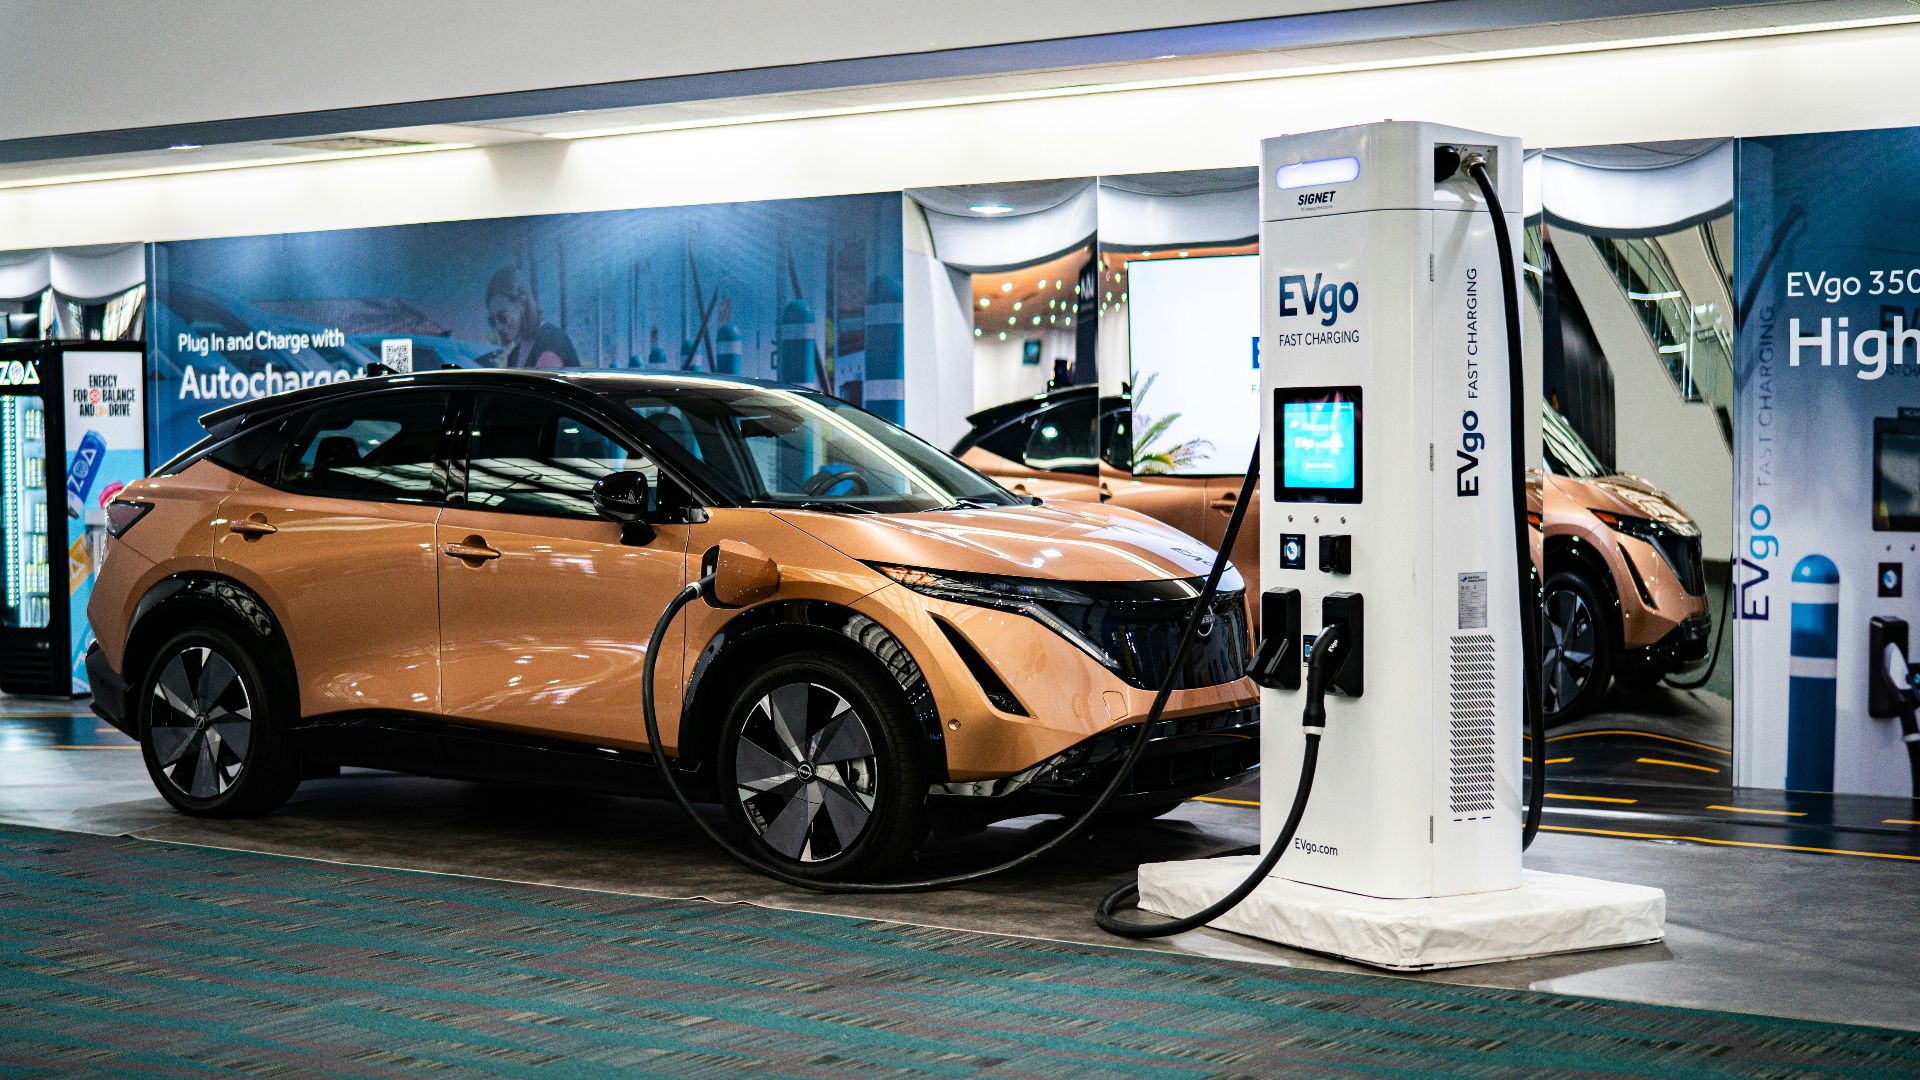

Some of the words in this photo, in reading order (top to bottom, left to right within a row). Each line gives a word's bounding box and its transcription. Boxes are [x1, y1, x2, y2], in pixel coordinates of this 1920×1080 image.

[1298, 190, 1336, 206] SIGNET
[1279, 273, 1359, 327] EVgo
[1787, 271, 1861, 303] EVgo
[1868, 268, 1920, 295] 350
[1466, 268, 1478, 355] CHARGING
[178, 333, 209, 357] Plug
[211, 332, 225, 352] In
[227, 331, 254, 352] and
[256, 329, 310, 354] Charge
[312, 327, 345, 349] with
[1279, 333, 1303, 347] FAST
[1305, 329, 1360, 346] CHARGING
[1789, 315, 1920, 381] High
[89, 374, 118, 388] ENERGY
[1468, 359, 1478, 399] FAST
[1759, 306, 1775, 427] CHARGING
[73, 389, 88, 403] FOR
[102, 388, 136, 403] BALANCE
[79, 403, 95, 417] AND
[108, 403, 131, 417] DRIVE
[1457, 409, 1485, 497] EVgo
[1741, 504, 1779, 621] EVgo
[1295, 837, 1338, 856] EVgo.com
